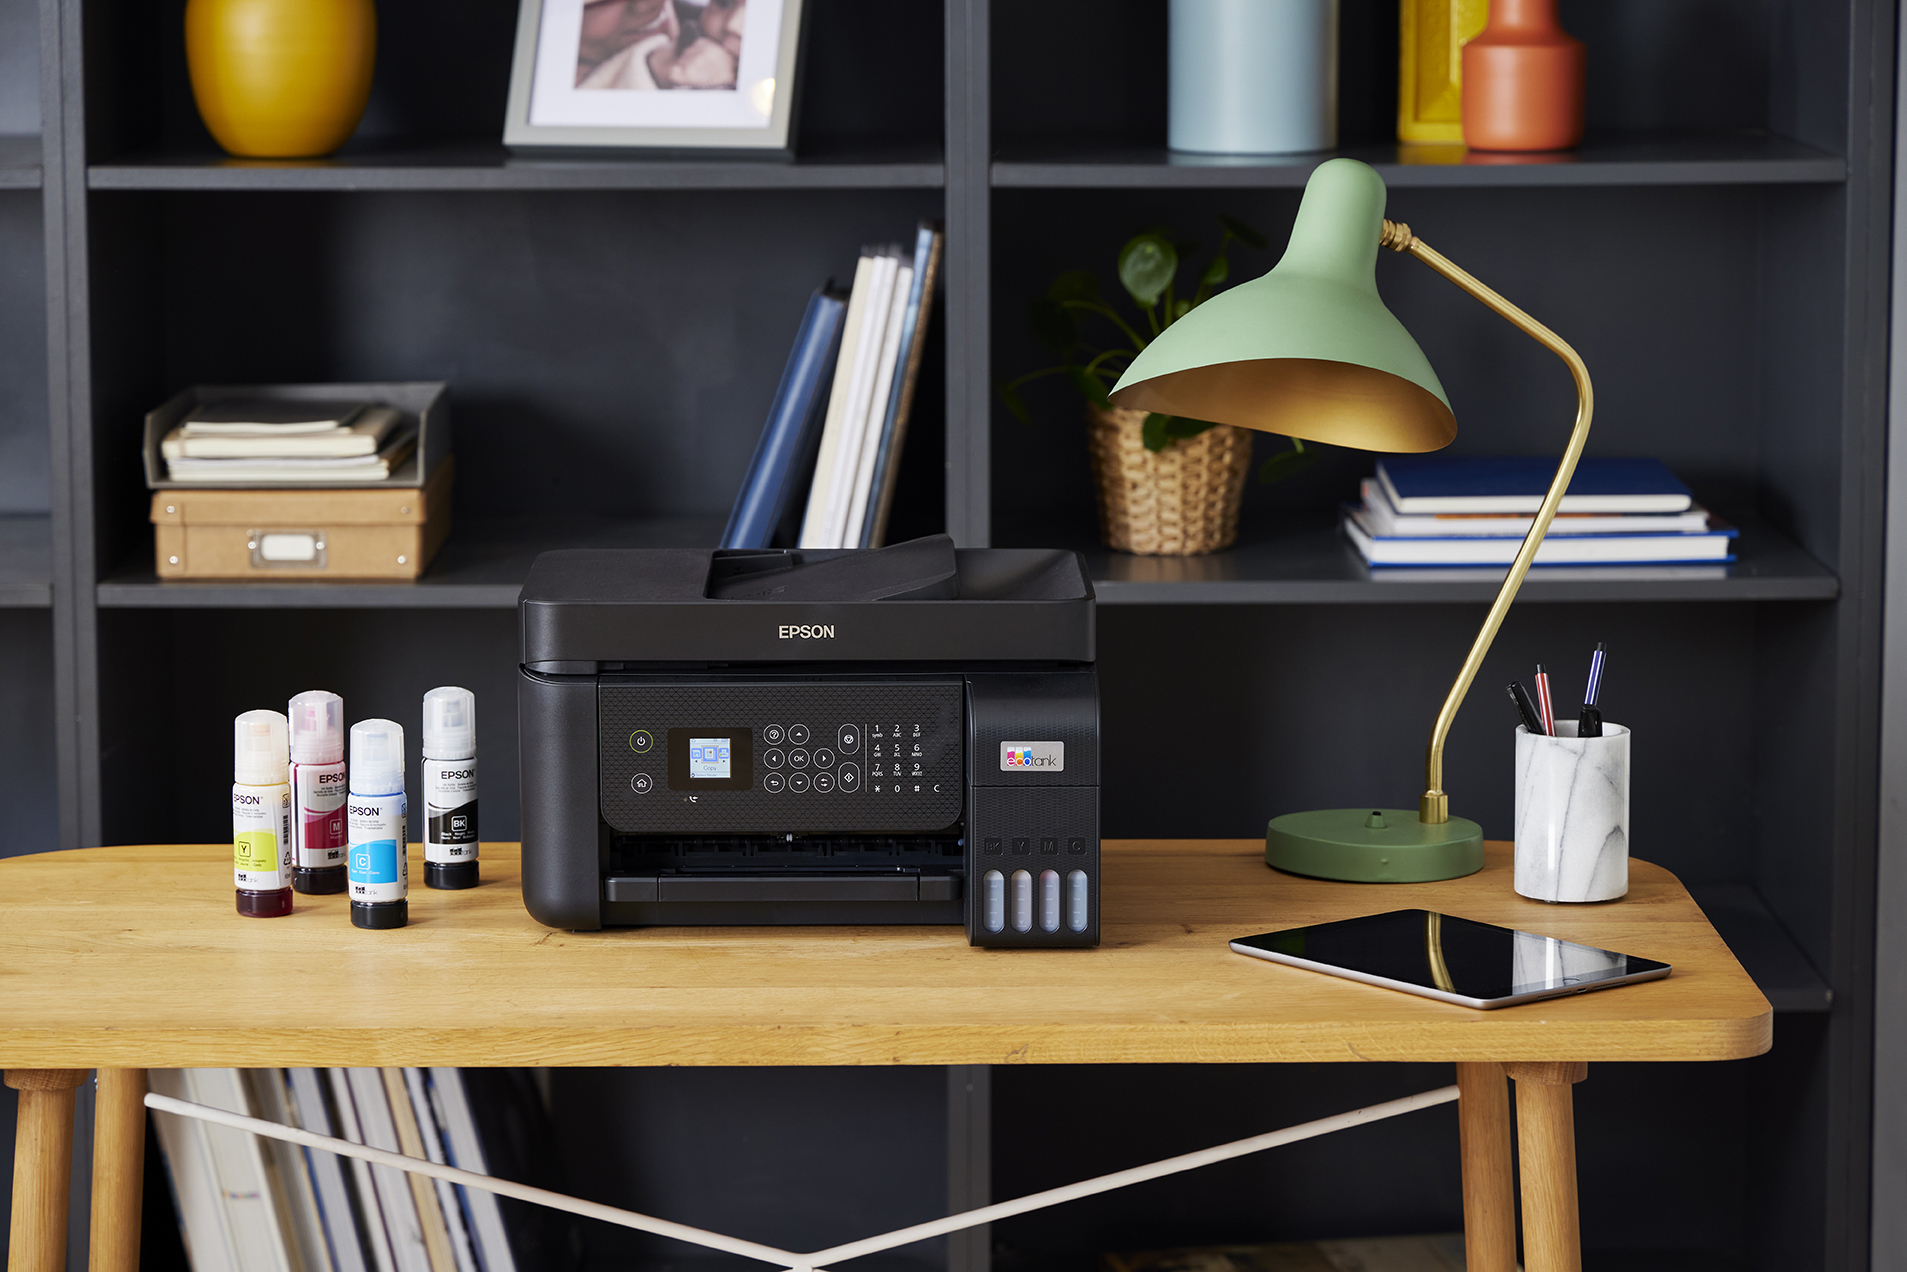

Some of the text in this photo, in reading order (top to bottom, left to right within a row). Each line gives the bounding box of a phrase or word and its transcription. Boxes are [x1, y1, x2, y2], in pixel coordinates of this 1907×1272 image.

[778, 624, 835, 639] EPSON
[875, 724, 879, 732] 1
[894, 724, 900, 732] 2
[914, 724, 920, 732] 3
[894, 744, 900, 752] 5
[913, 744, 920, 752] 6
[1006, 752, 1057, 767] ecotank
[874, 763, 881, 771] 7
[894, 763, 900, 771] 8
[913, 763, 920, 771] 9
[441, 769, 475, 780] EPSON
[894, 784, 901, 793] 0
[933, 784, 940, 793] C
[349, 804, 380, 817] EPSON
[333, 822, 341, 832] M
[453, 819, 466, 828] BK
[241, 844, 247, 854] Y
[1016, 841, 1025, 852] Y
[1043, 841, 1054, 852] M
[1072, 841, 1081, 852] C
[358, 856, 367, 867] C
